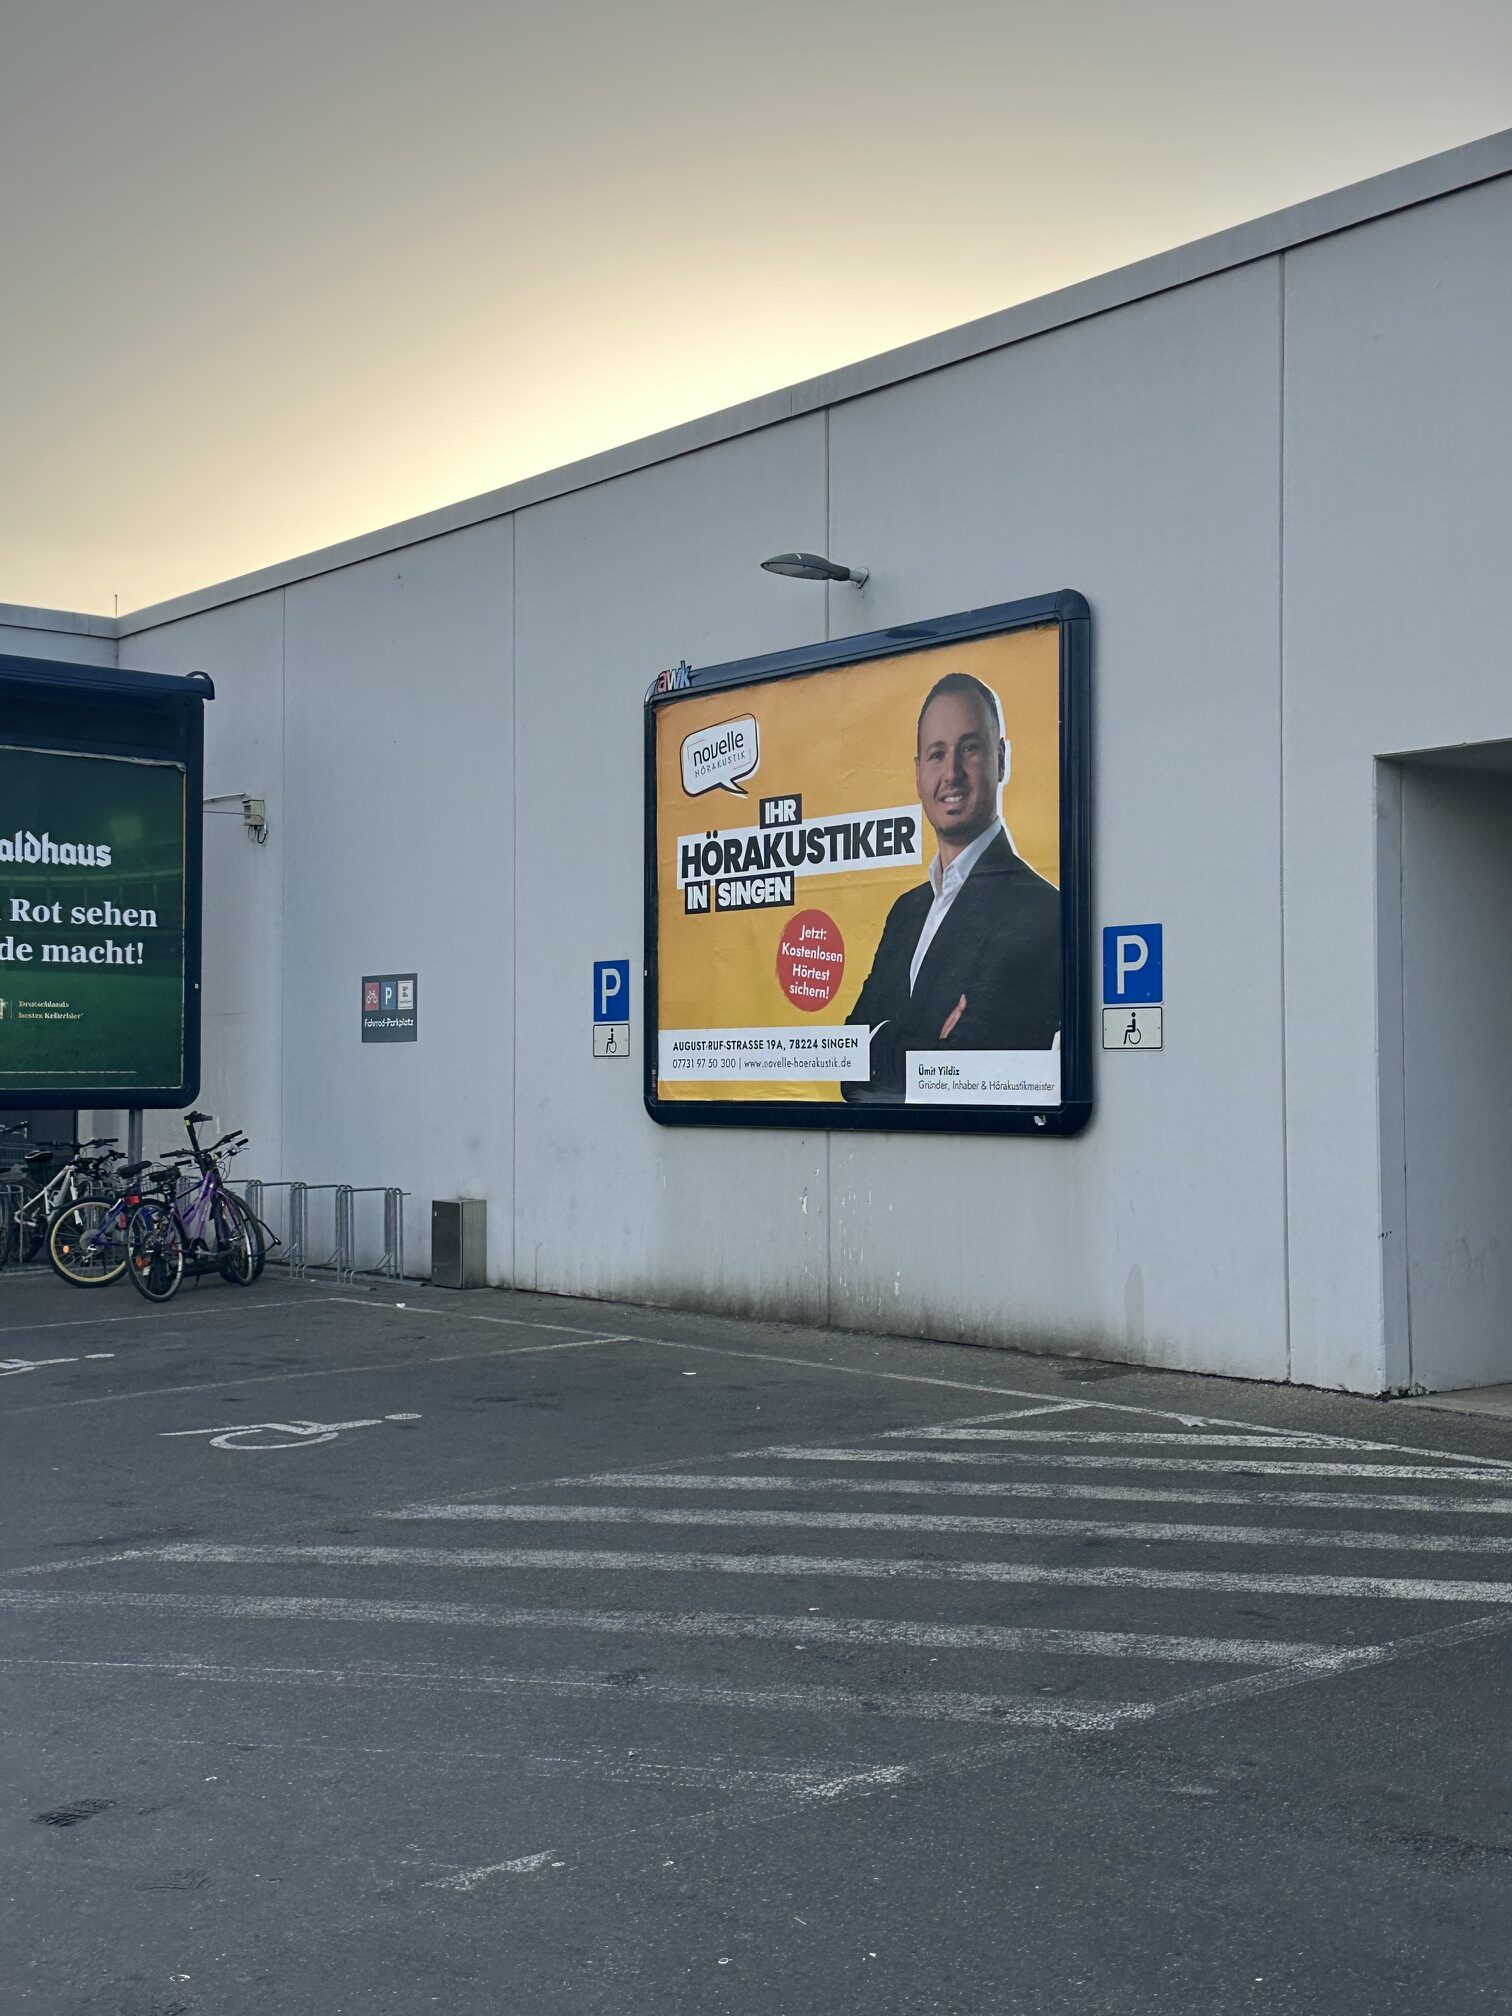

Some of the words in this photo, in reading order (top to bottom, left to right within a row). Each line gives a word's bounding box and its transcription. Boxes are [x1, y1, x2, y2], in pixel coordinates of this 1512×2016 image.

[657, 660, 692, 692] awk
[693, 731, 744, 767] novelle
[694, 751, 746, 778] HÖRAKUSTIK
[765, 799, 797, 825] IHR
[681, 815, 916, 879] HÖRAKUSTIKER
[687, 885, 708, 910] IN
[717, 876, 791, 907] SINGEN
[9, 898, 63, 924] Rot
[70, 901, 158, 927] sehen
[798, 924, 827, 941] Jetzt:
[41, 939, 144, 965] macht!
[781, 941, 843, 963] Kostenlosen
[1116, 934, 1149, 995] P
[792, 963, 830, 981] Hörtest
[385, 986, 393, 1005] P
[601, 968, 622, 1015] P
[789, 981, 830, 1000] sichern!
[672, 1039, 764, 1051] AUGUST-RUF-STRASSE
[766, 1039, 786, 1052] 19A,
[789, 1038, 819, 1049] 78224
[821, 1037, 859, 1049] SINGEN
[672, 1058, 694, 1069] 07731
[696, 1058, 706, 1069] 97
[708, 1058, 718, 1068] 50
[720, 1058, 736, 1068] 300
[918, 1063, 936, 1076] Ümit
[918, 1079, 950, 1092] Gründer,
[952, 1080, 979, 1091] Inhaber
[980, 1080, 988, 1091] &
[989, 1080, 1055, 1091] Hörakustikmeister
